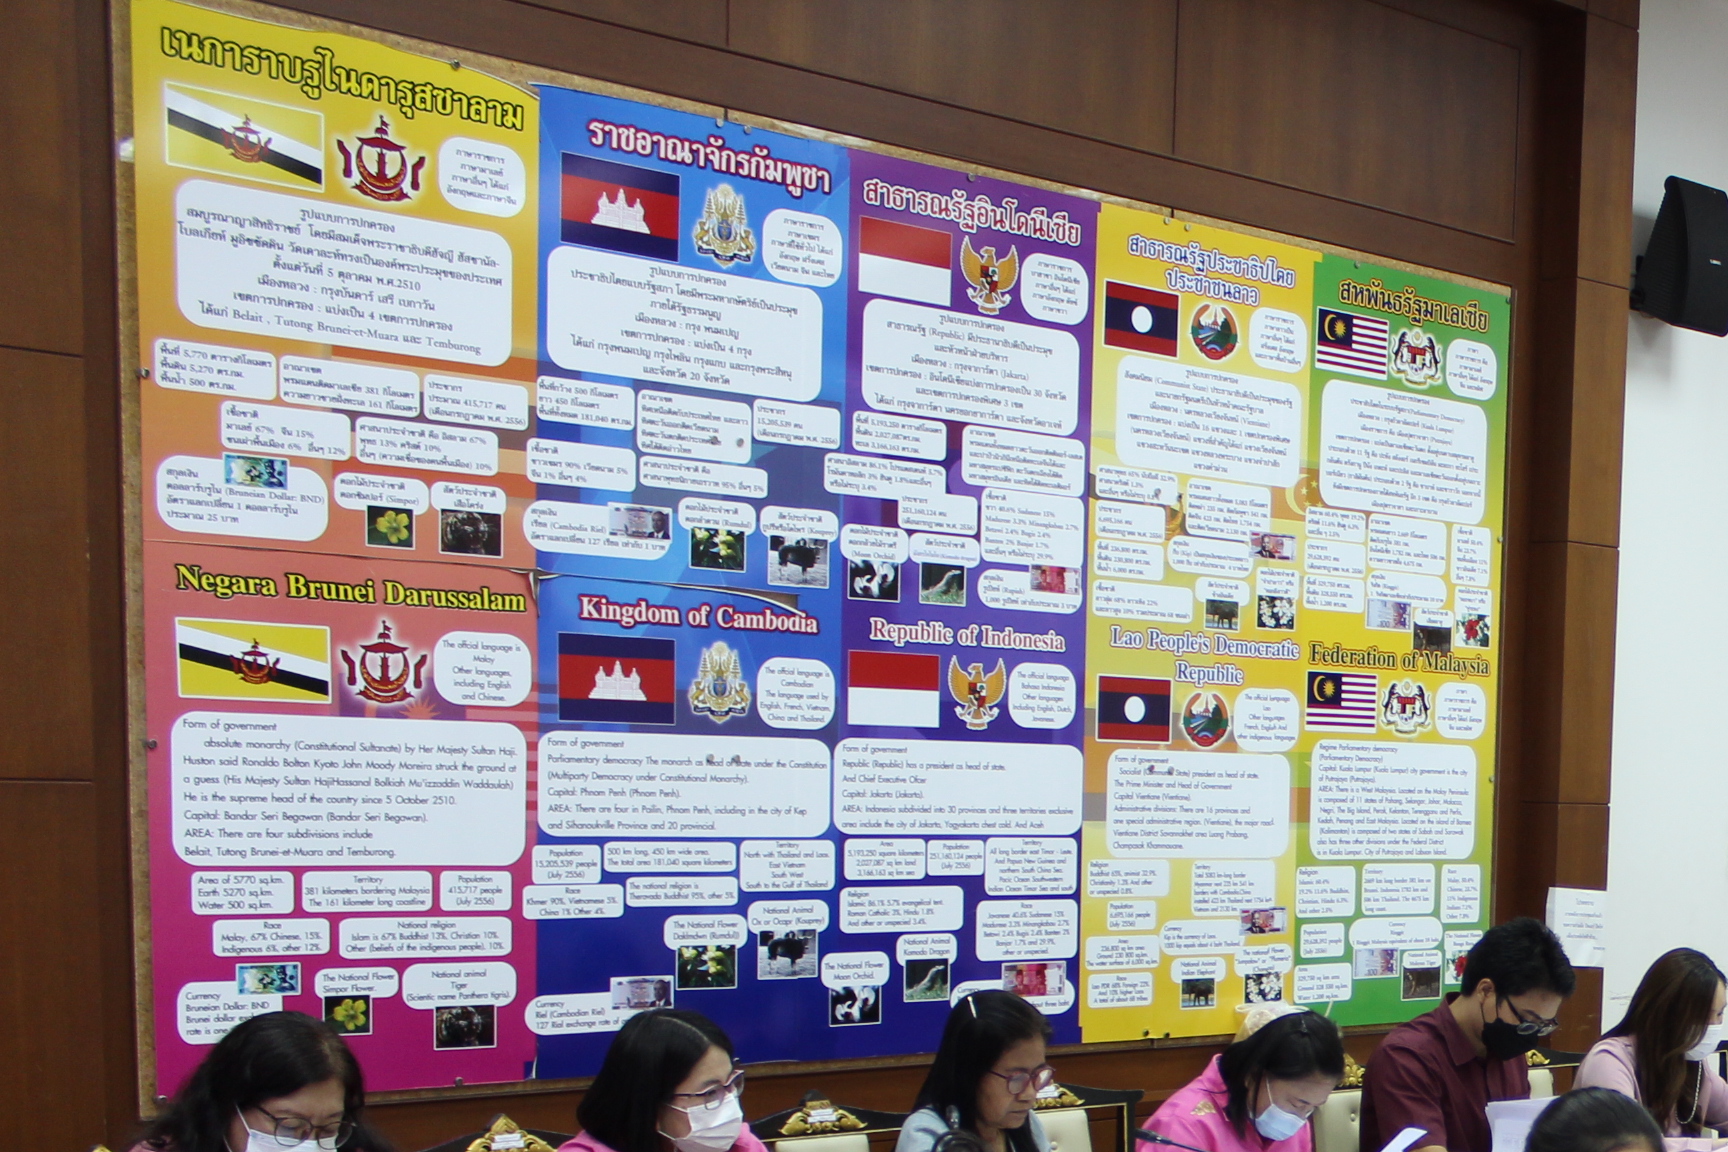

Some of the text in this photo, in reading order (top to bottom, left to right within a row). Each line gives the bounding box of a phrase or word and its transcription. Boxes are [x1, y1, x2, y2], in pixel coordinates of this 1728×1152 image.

[161, 27, 523, 131] เนการาบรูไนดารุสซาลาม
[587, 119, 830, 196] ราชอาณาจักรกัมพูชา
[299, 209, 395, 232] รูปแบบการปกครอง
[863, 179, 1081, 245] สาธารณรัฐอินโดนีเซีย
[1127, 234, 1296, 289] สาธารณรัฐประชาธิปไตย
[1165, 267, 1260, 307] ประชาชนลาว
[1339, 278, 1490, 333] สหพันธรัฐมาเลเซีย
[175, 564, 525, 612] Negara Brunei Darussalam
[579, 594, 819, 634] Kingdom of Cambodia
[870, 616, 1065, 652] Republic of Indonesia
[1110, 625, 1299, 660] Lao People's Democratic
[1175, 660, 1244, 687] Republic
[1309, 643, 1490, 679] Federation of Malaysia
[182, 718, 277, 732] Form of government
[203, 736, 242, 748] absolute
[245, 739, 291, 752] monarchy
[294, 740, 356, 751] (Constitutional
[359, 742, 401, 753] Sultanate)
[404, 742, 415, 755] by
[418, 744, 434, 753] Her
[436, 745, 468, 756] Majesty
[471, 745, 496, 755] Sultan
[547, 736, 624, 749] Form of government
[842, 743, 907, 755] Form of government
[183, 755, 215, 765] Huston
[219, 755, 238, 766] said
[242, 756, 280, 767] Ronaldo
[313, 758, 339, 770] Kyoto
[341, 758, 362, 769] John
[365, 759, 396, 771] Moody
[435, 761, 458, 771] struck
[461, 761, 474, 771] the
[476, 762, 506, 774] ground
[193, 776, 220, 786] guess
[223, 774, 241, 785] (His
[244, 775, 280, 787] Majesty
[283, 775, 311, 786] Sultan
[374, 777, 405, 787] Bolkiah
[183, 791, 456, 806] He is the supreme head of the country since 5 October 2510.
[183, 809, 428, 824] Capital: Bandar Seri Begawan (Bandar Seri Begawan).
[184, 827, 214, 838] AREA:
[217, 827, 243, 838] There
[265, 827, 284, 838] four
[287, 828, 339, 839] subdivisions
[342, 828, 373, 839] include
[184, 846, 396, 859] Belait, Tutong Brunei-et-Muara and Temburong.
